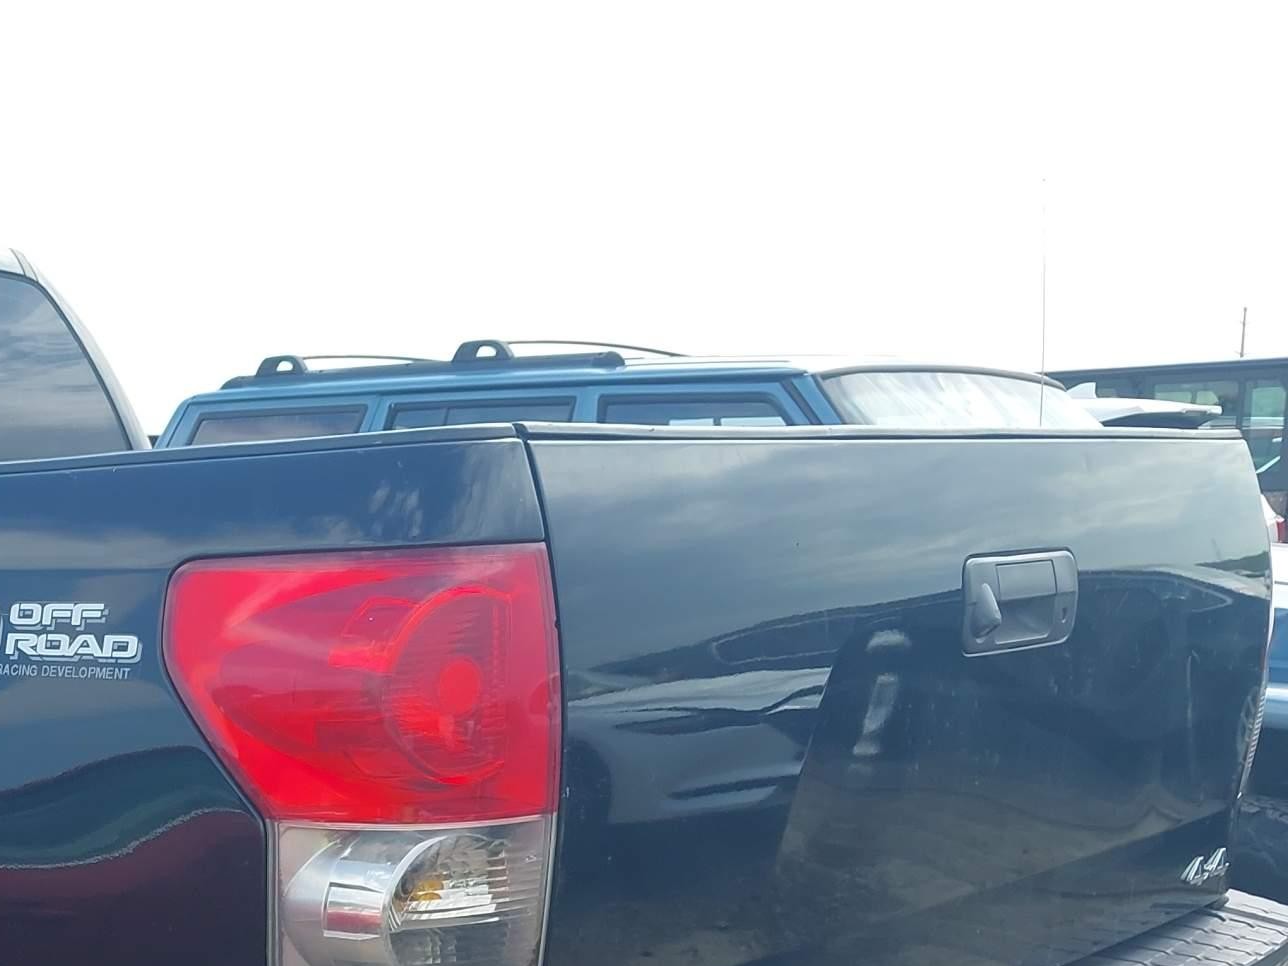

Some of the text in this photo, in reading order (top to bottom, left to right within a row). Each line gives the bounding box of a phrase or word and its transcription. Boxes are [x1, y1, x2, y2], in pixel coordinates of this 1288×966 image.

[9, 602, 110, 630] OFF
[5, 632, 143, 664] ROAD
[41, 665, 132, 681] DEVELOPMENT
